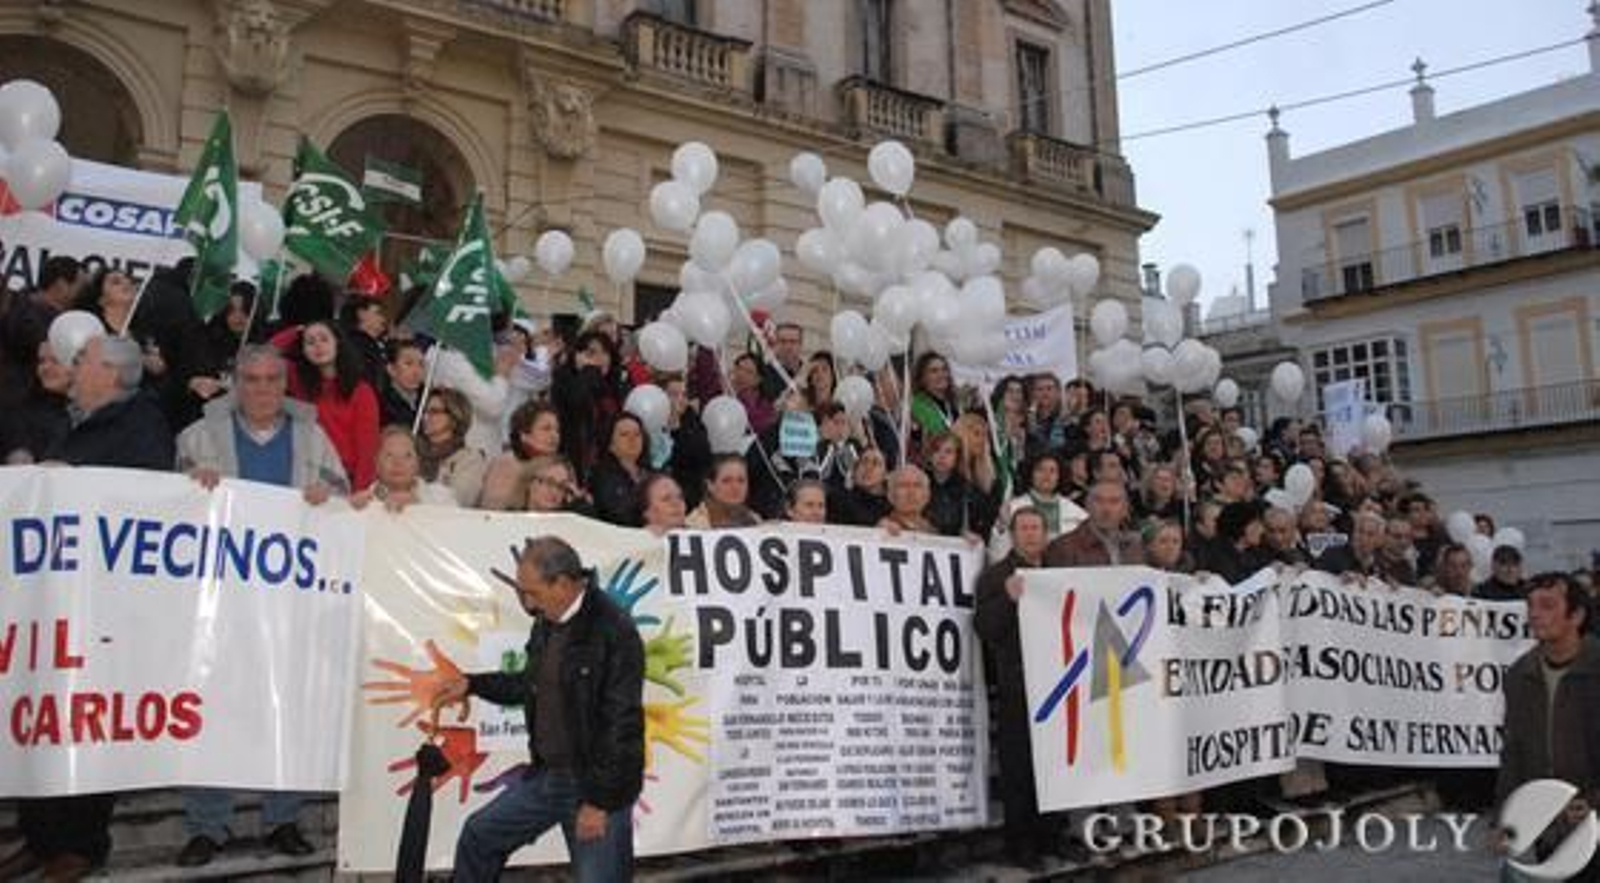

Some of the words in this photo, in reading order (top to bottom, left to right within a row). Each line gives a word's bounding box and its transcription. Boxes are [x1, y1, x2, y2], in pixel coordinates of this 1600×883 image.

[12, 515, 80, 575] DE
[667, 533, 975, 609] HOSPITAL
[696, 605, 961, 674] PÚBLICO
[1371, 598, 1415, 635] LAS
[1421, 601, 1520, 641] PEÑAS
[10, 691, 204, 747] CARLOS
[1186, 719, 1290, 778] HOSPIT
[1346, 715, 1397, 754] SAN
